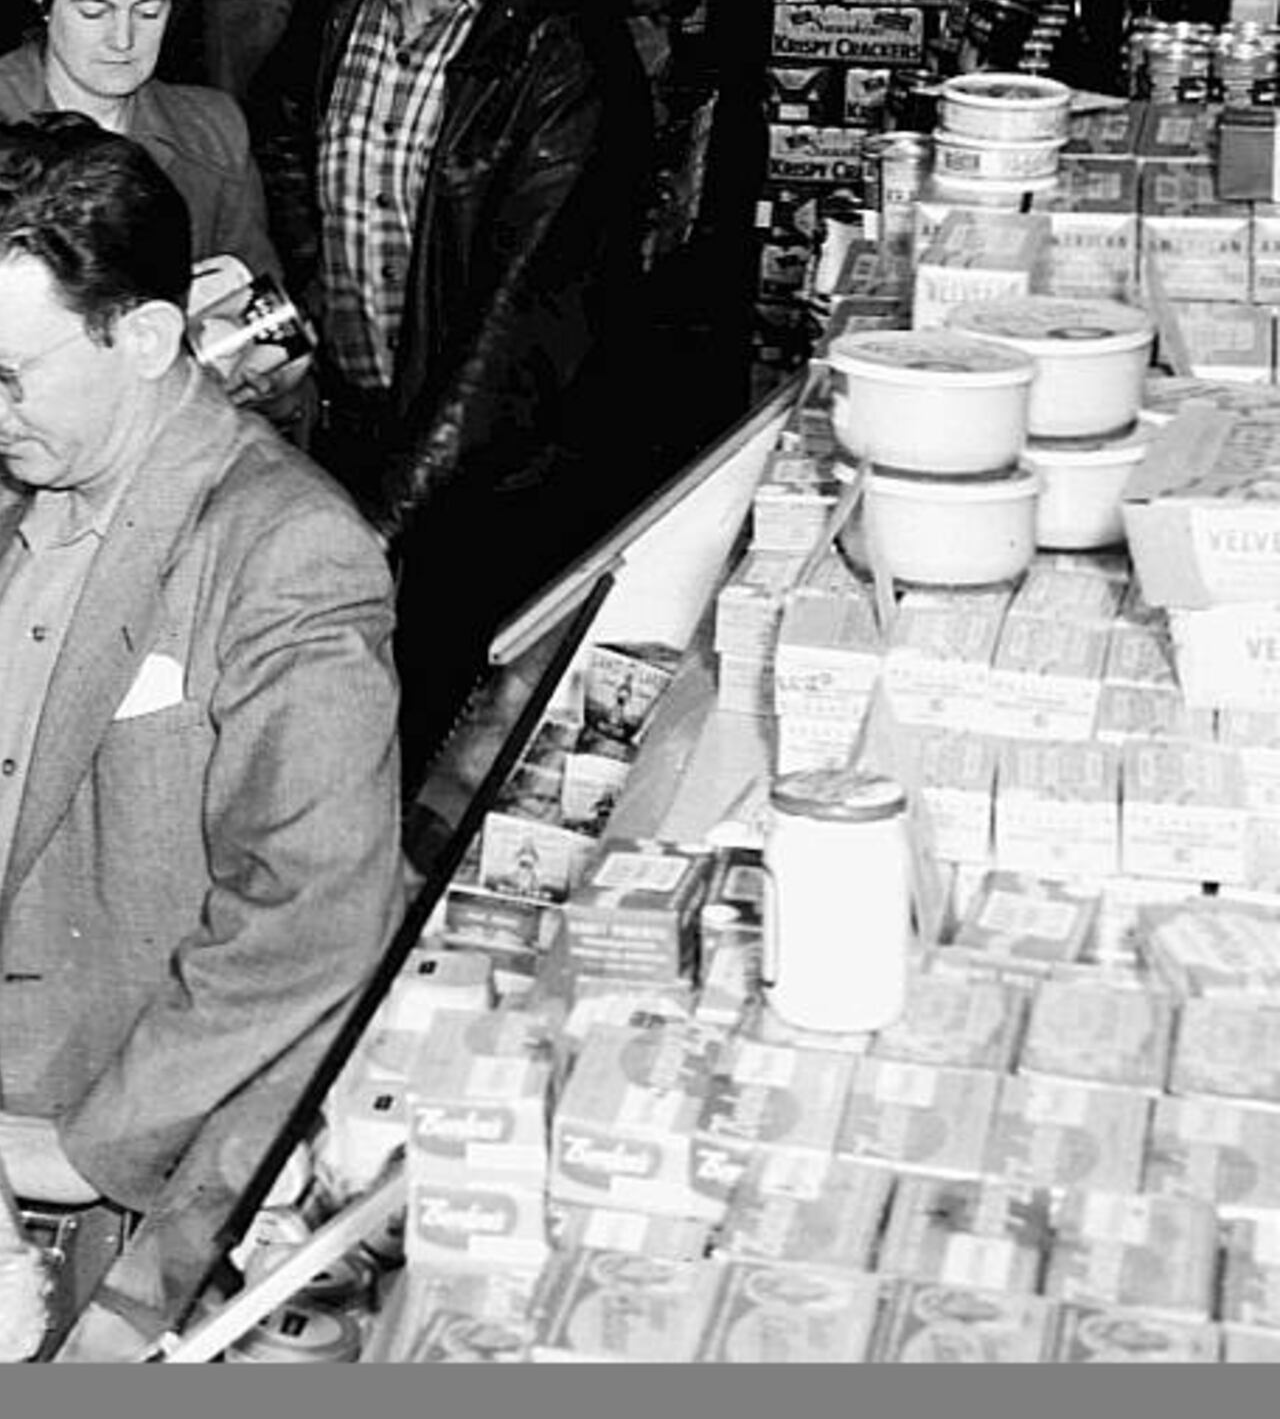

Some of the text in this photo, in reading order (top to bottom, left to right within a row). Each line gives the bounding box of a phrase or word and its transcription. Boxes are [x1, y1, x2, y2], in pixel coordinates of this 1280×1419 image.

[772, 36, 922, 60] KRISPY CRACKERS
[769, 158, 826, 177] KRISPY
